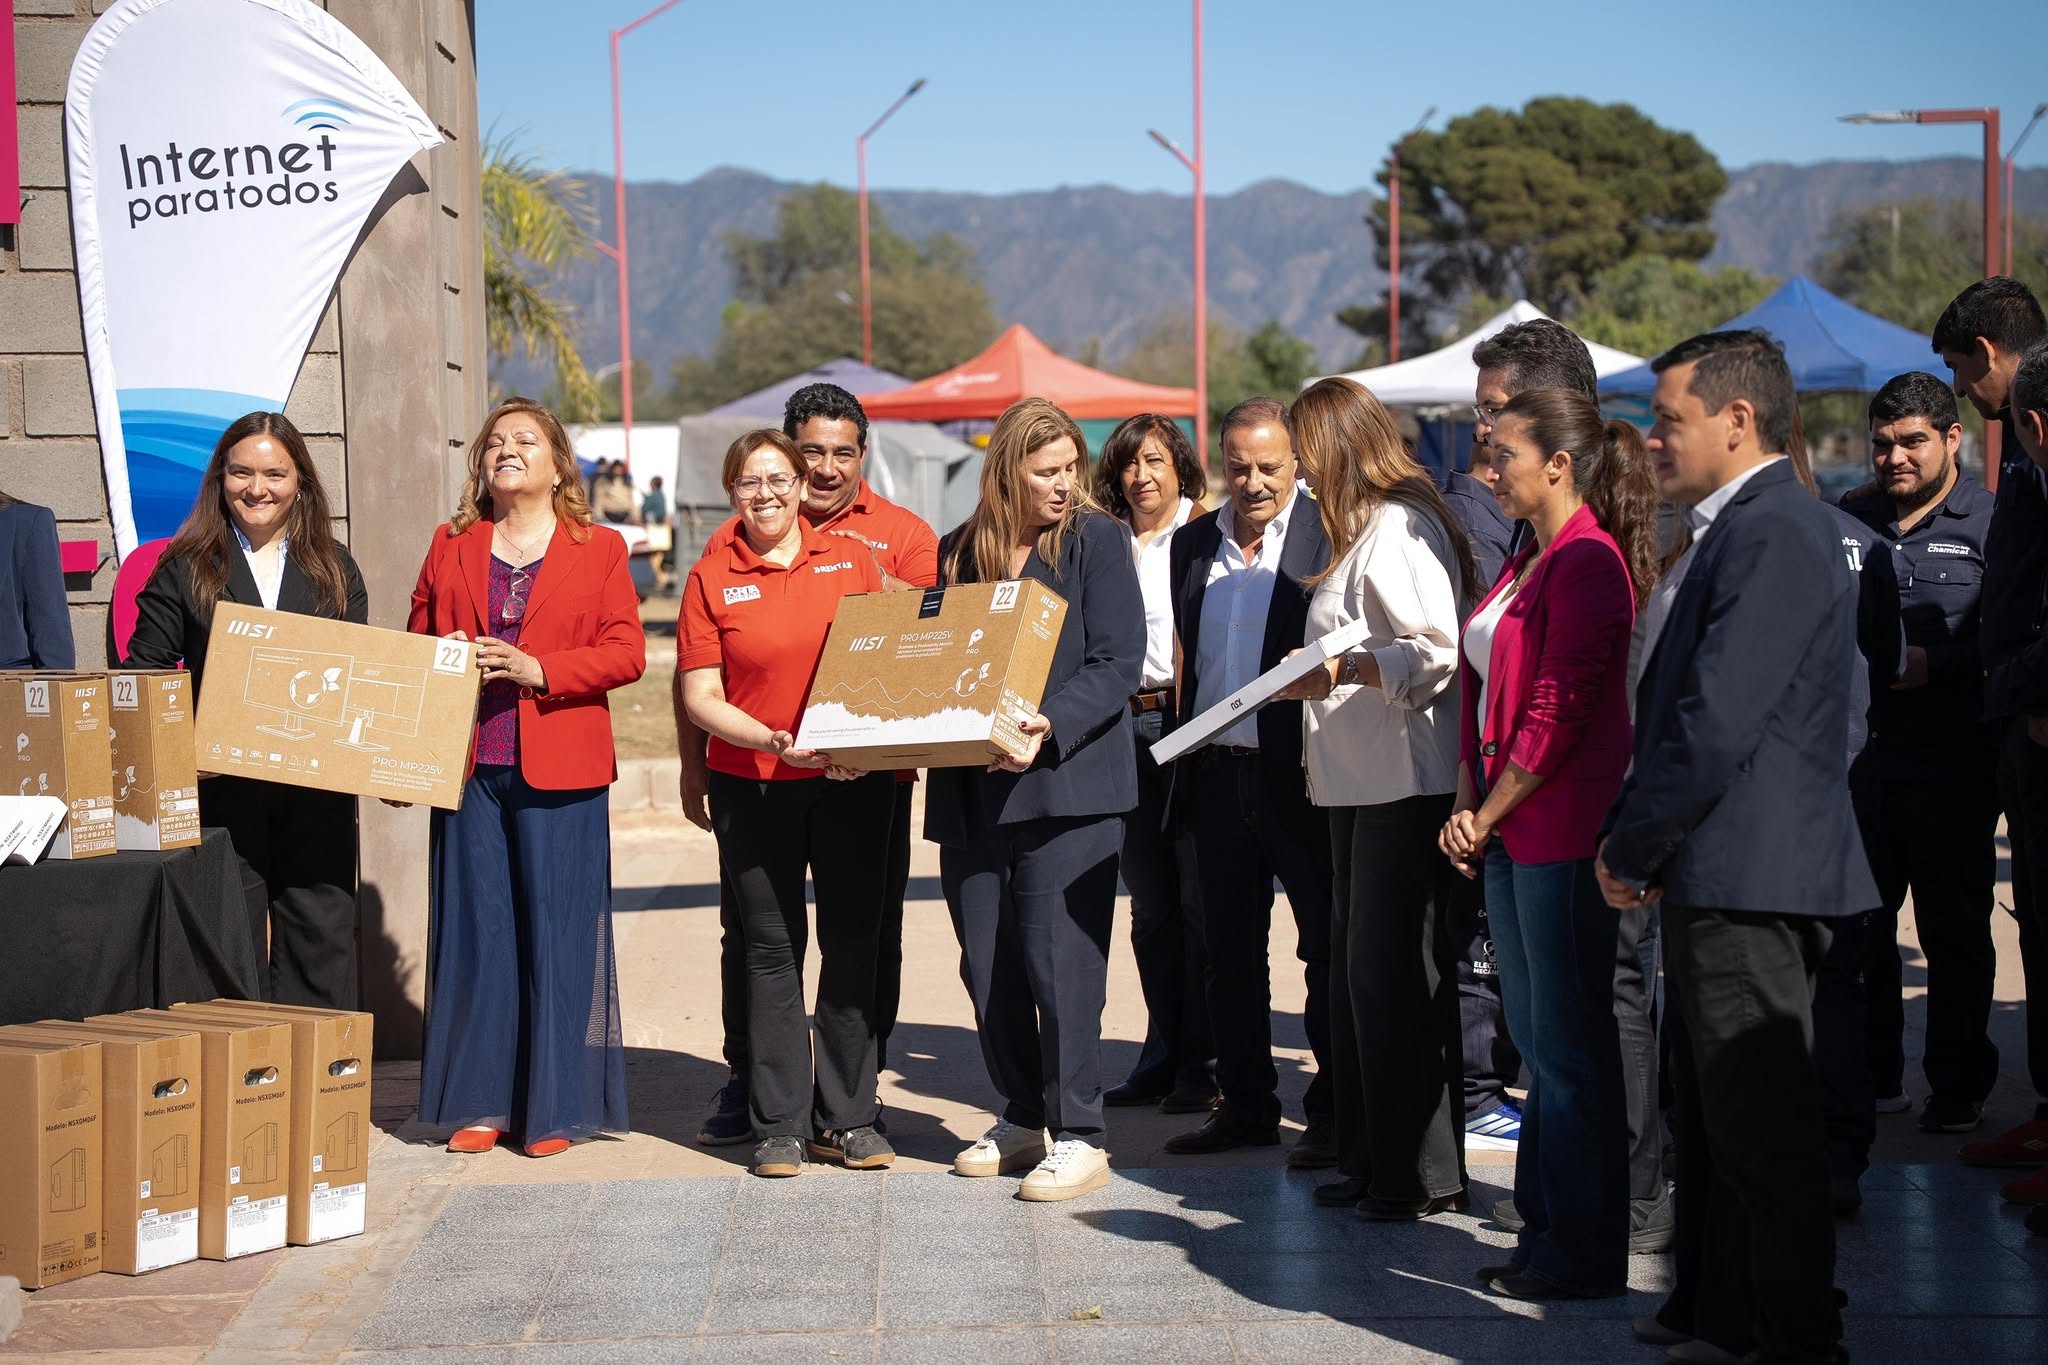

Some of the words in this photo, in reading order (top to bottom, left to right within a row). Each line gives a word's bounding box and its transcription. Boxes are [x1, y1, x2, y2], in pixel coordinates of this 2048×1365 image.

[119, 135, 337, 190] Internet
[1927, 546, 1969, 555] Chamical
[821, 562, 853, 573] RENTAS
[996, 586, 1015, 605] 22
[1040, 595, 1060, 611] MSI
[227, 620, 278, 640] MSI
[900, 633, 919, 642] PRO
[919, 630, 954, 641] MP225V
[849, 635, 887, 652] MSI
[440, 646, 462, 668] 22
[75, 687, 97, 697] MSI
[117, 682, 133, 702] 22
[162, 680, 183, 690] MSI
[30, 687, 44, 708] 22
[373, 756, 397, 768] PRO
[400, 760, 444, 775] MP225V
[1473, 960, 1499, 969] ELECT
[320, 1085, 340, 1094] Modelo:
[236, 1096, 257, 1105] Modelo:
[257, 1091, 286, 1102] NSXGM06F
[144, 1107, 166, 1117] Modelo:
[166, 1102, 196, 1113] NSXGM06F
[46, 1122, 67, 1132] Modelo:
[67, 1115, 97, 1127] NSXGM06F
